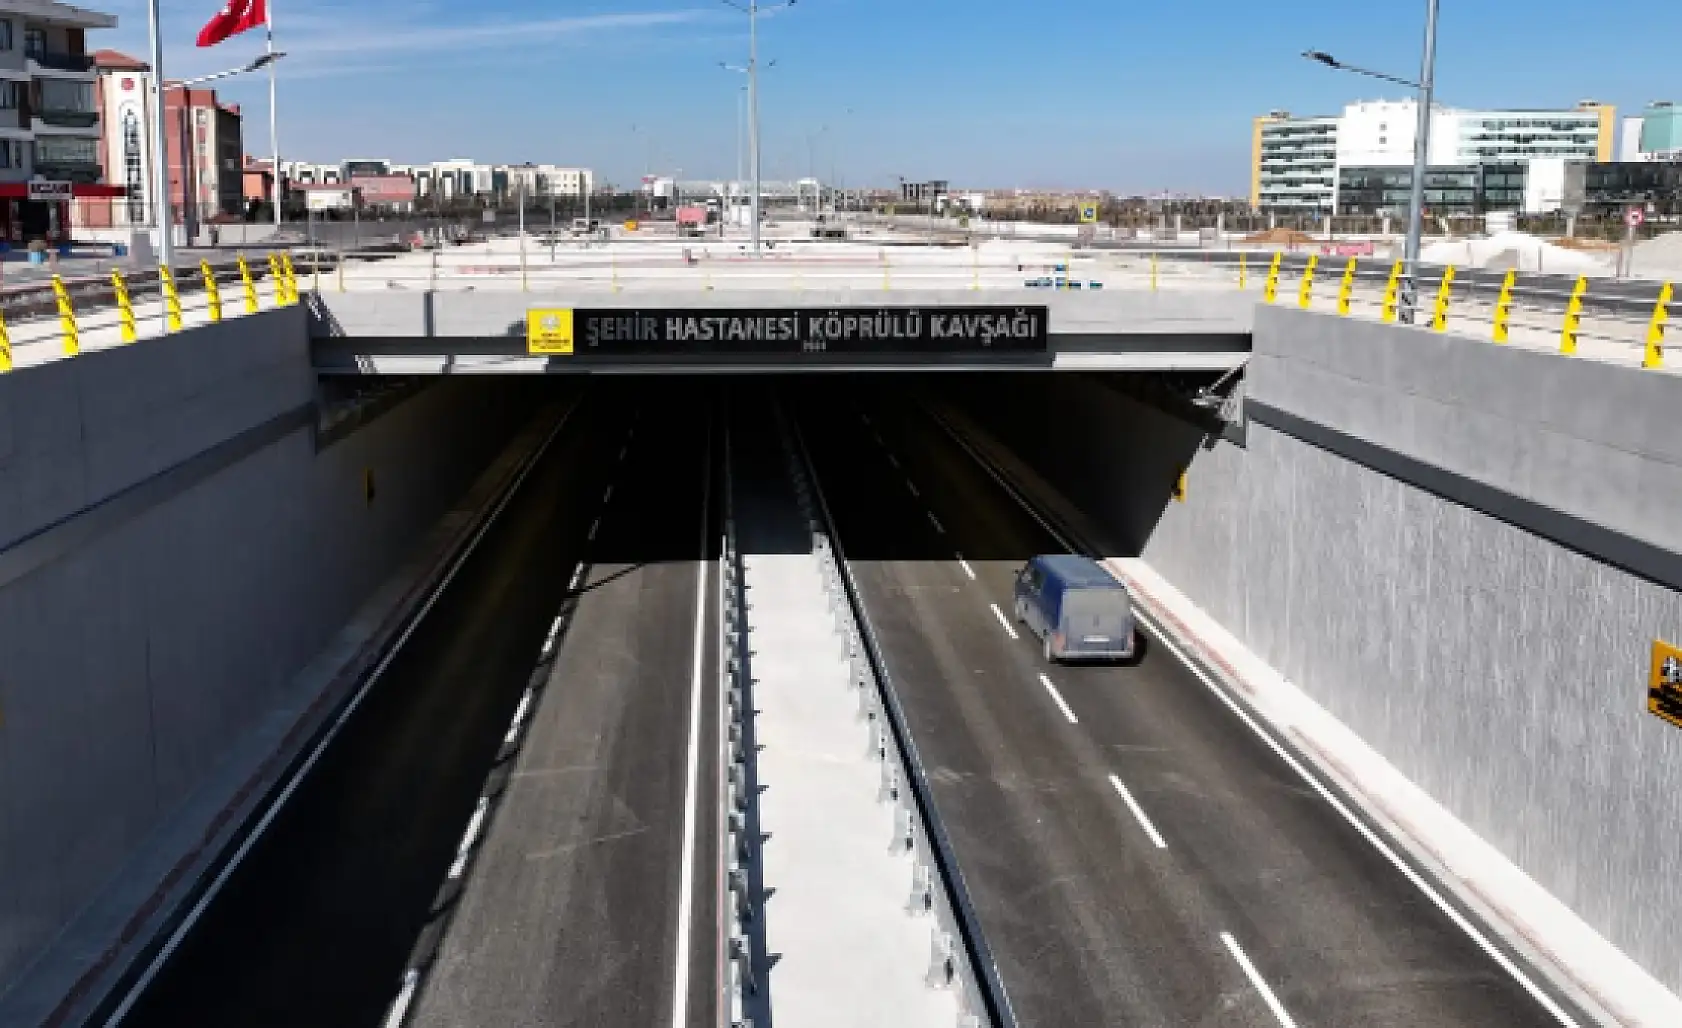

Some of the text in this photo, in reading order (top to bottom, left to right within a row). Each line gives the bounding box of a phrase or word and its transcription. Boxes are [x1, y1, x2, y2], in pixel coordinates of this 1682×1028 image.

[586, 311, 658, 346] ŞEHİR
[666, 311, 799, 340] HASTANESİ
[809, 308, 922, 340] KÖPRÜLÜ
[931, 307, 1038, 346] KAVŞAĞI
